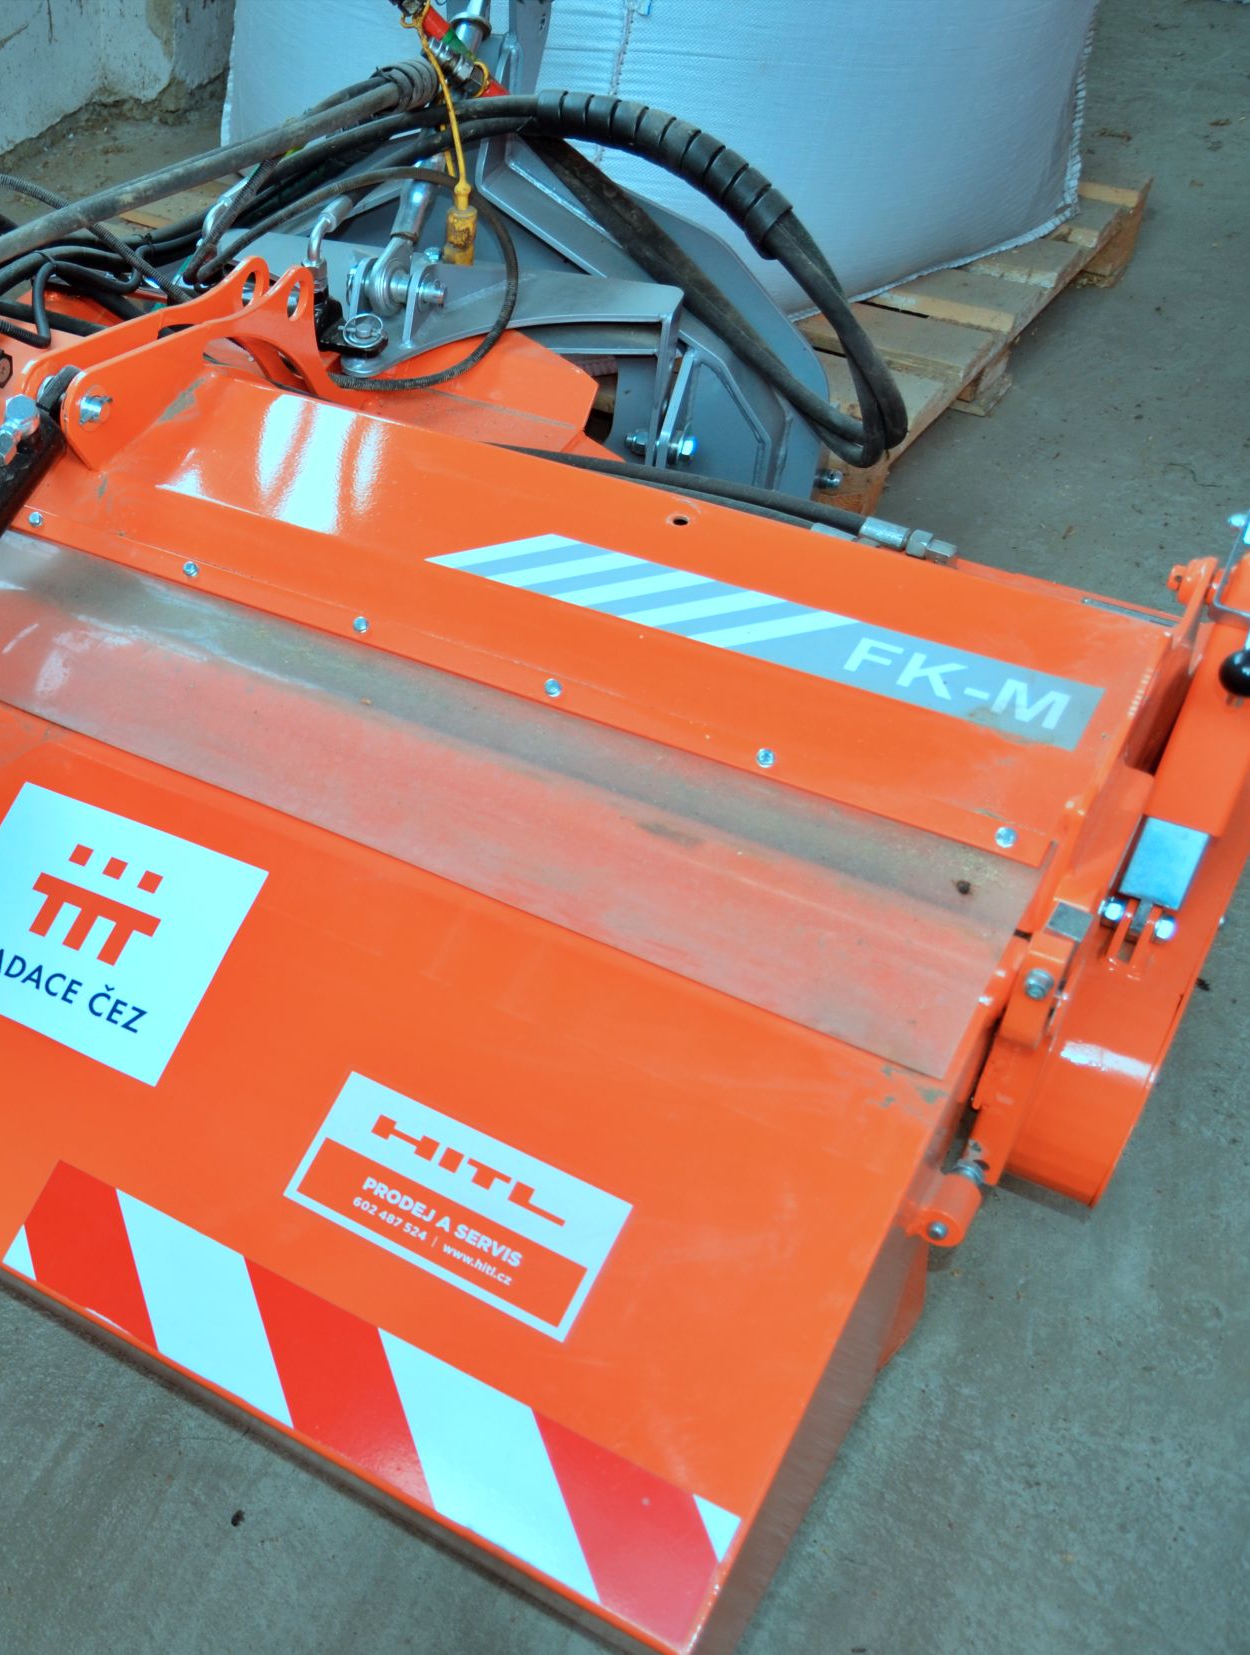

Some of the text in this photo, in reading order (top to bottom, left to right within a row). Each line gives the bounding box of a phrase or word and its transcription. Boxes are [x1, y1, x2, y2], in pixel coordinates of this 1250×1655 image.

[843, 637, 1071, 730] FK-M
[88, 984, 148, 1034] ČEZ
[371, 1114, 566, 1227] HITL
[352, 1197, 513, 1286] 602 487 524 www.hitl.cz
[362, 1176, 523, 1268] PRODEJ A SERVIS
